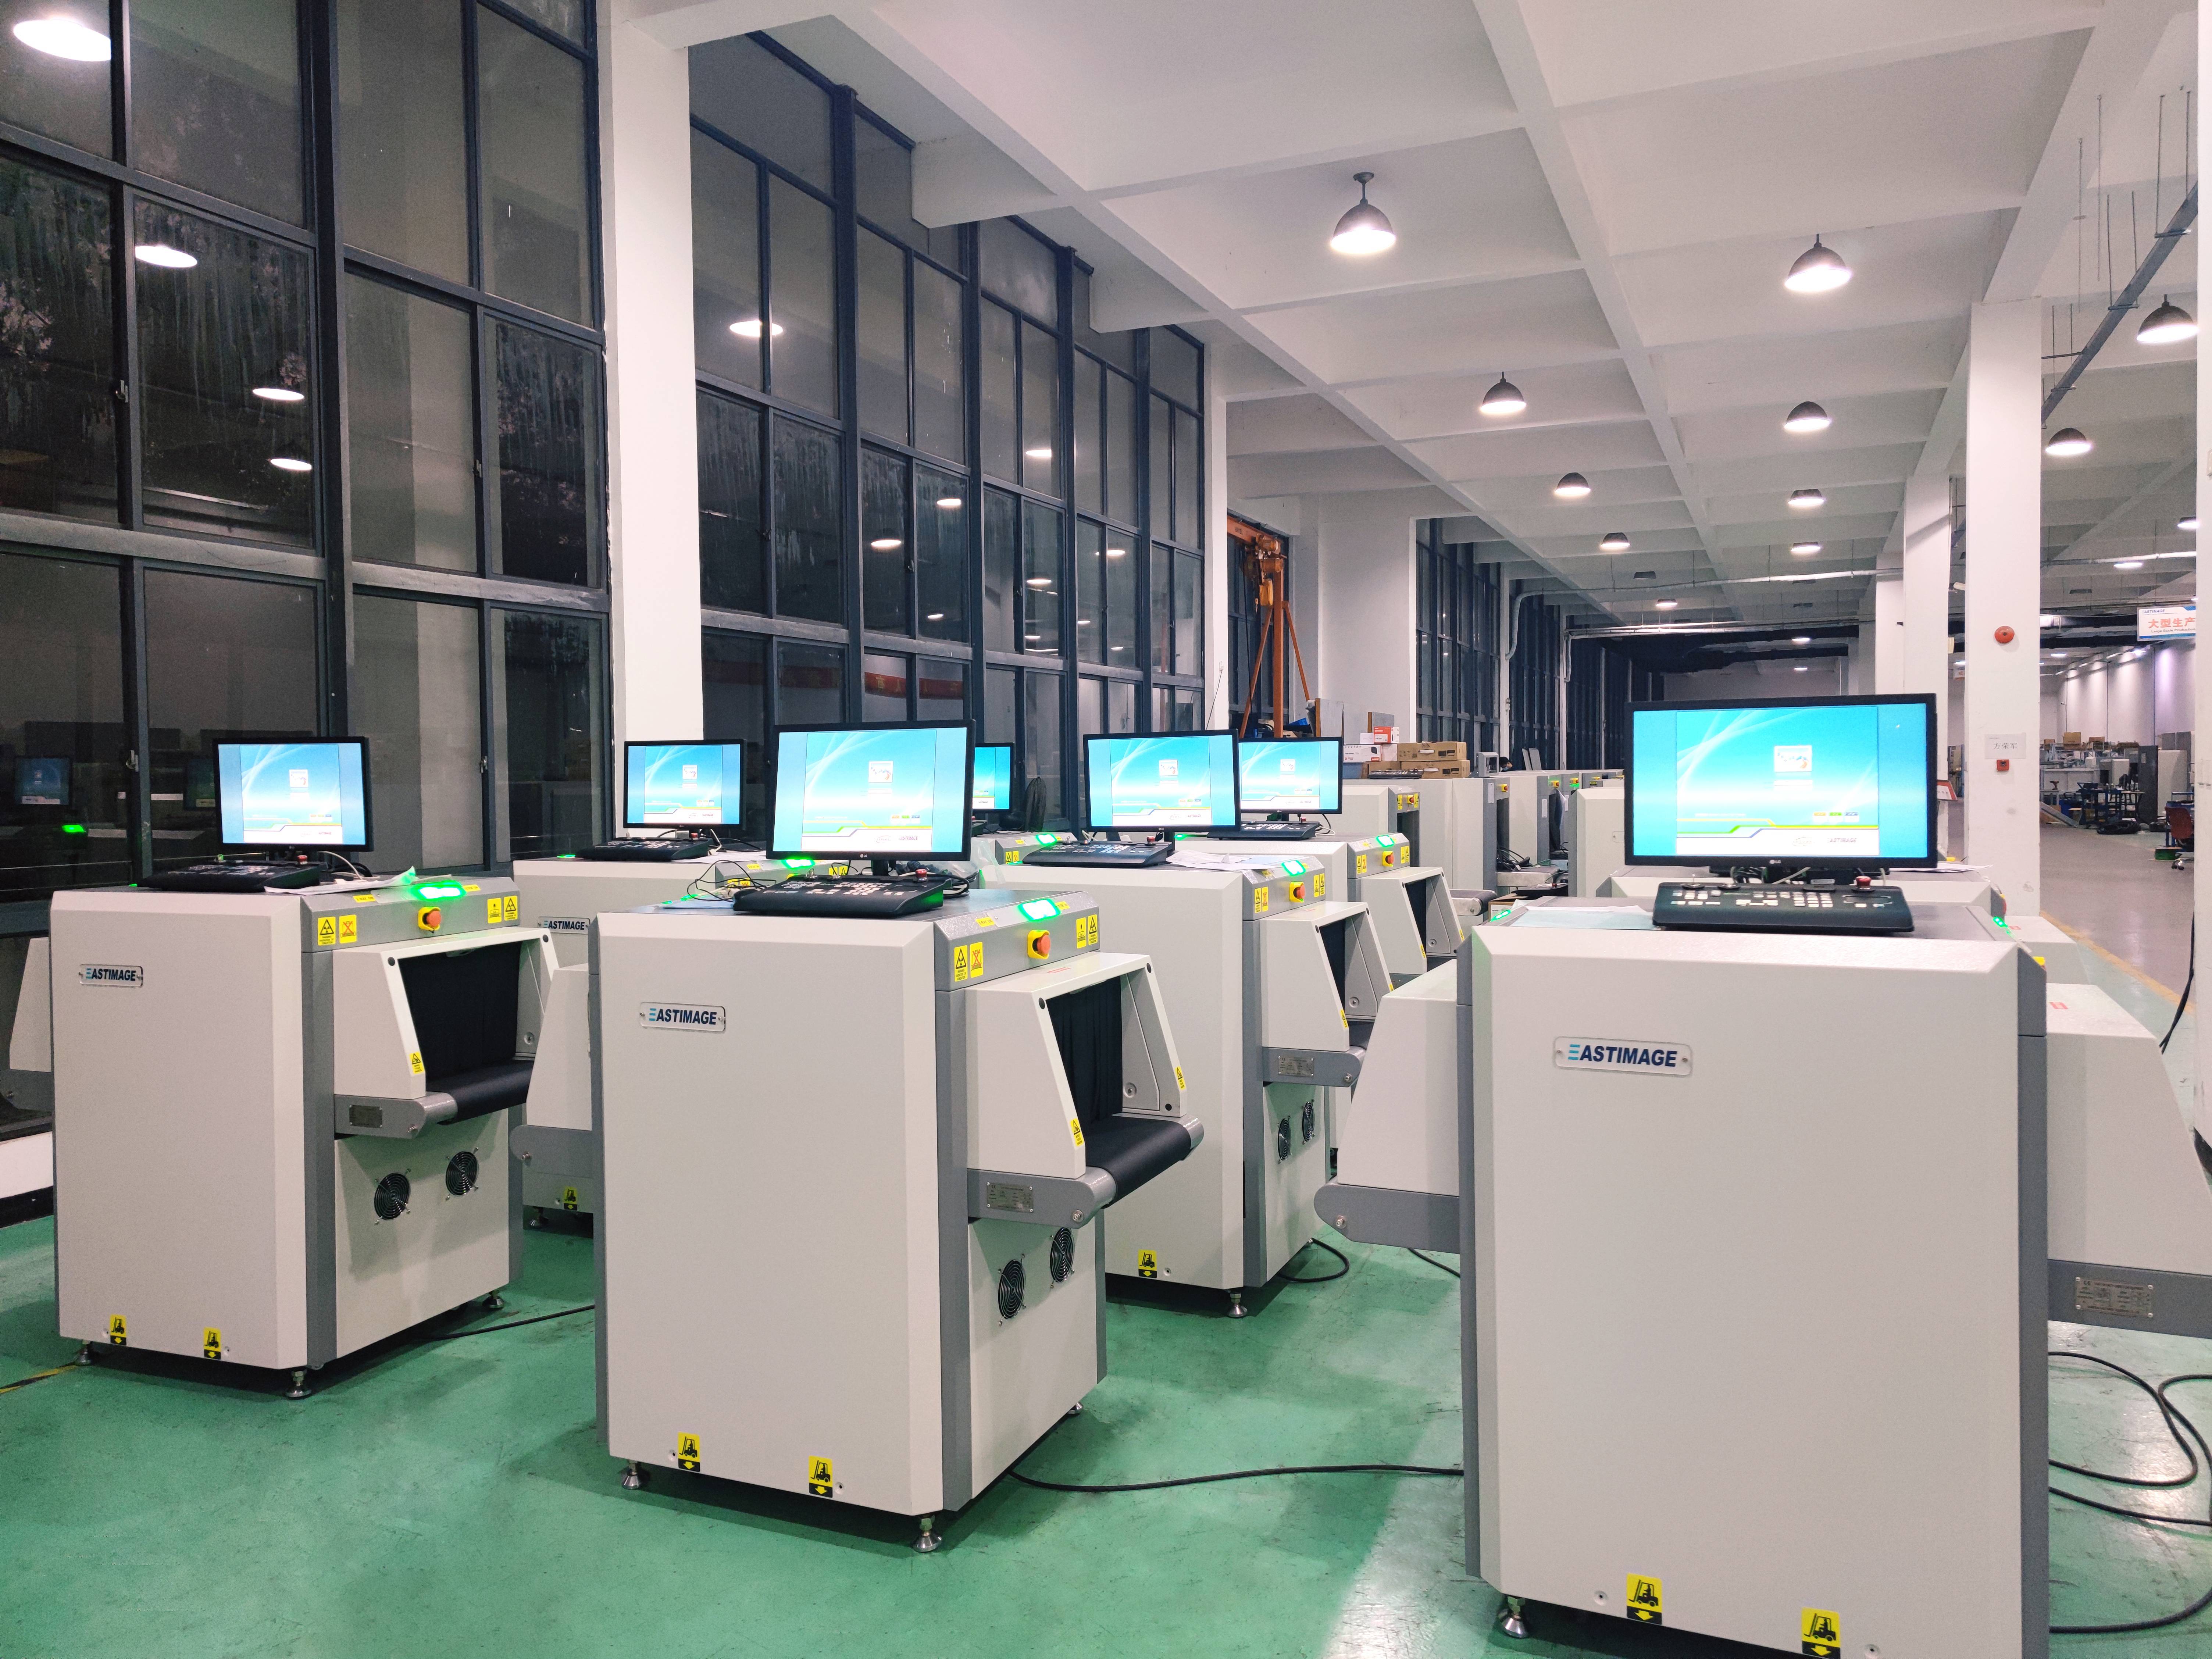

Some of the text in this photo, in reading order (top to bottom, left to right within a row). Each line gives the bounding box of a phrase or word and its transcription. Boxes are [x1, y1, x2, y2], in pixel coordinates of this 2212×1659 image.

[2148, 617, 2195, 628] 大型生产
[543, 920, 585, 930] EASTIMAGE
[86, 968, 136, 981] EASTIMAGE
[649, 1008, 717, 1025] EASTIMAGE
[1568, 1044, 1677, 1067] EASTIMAGE
